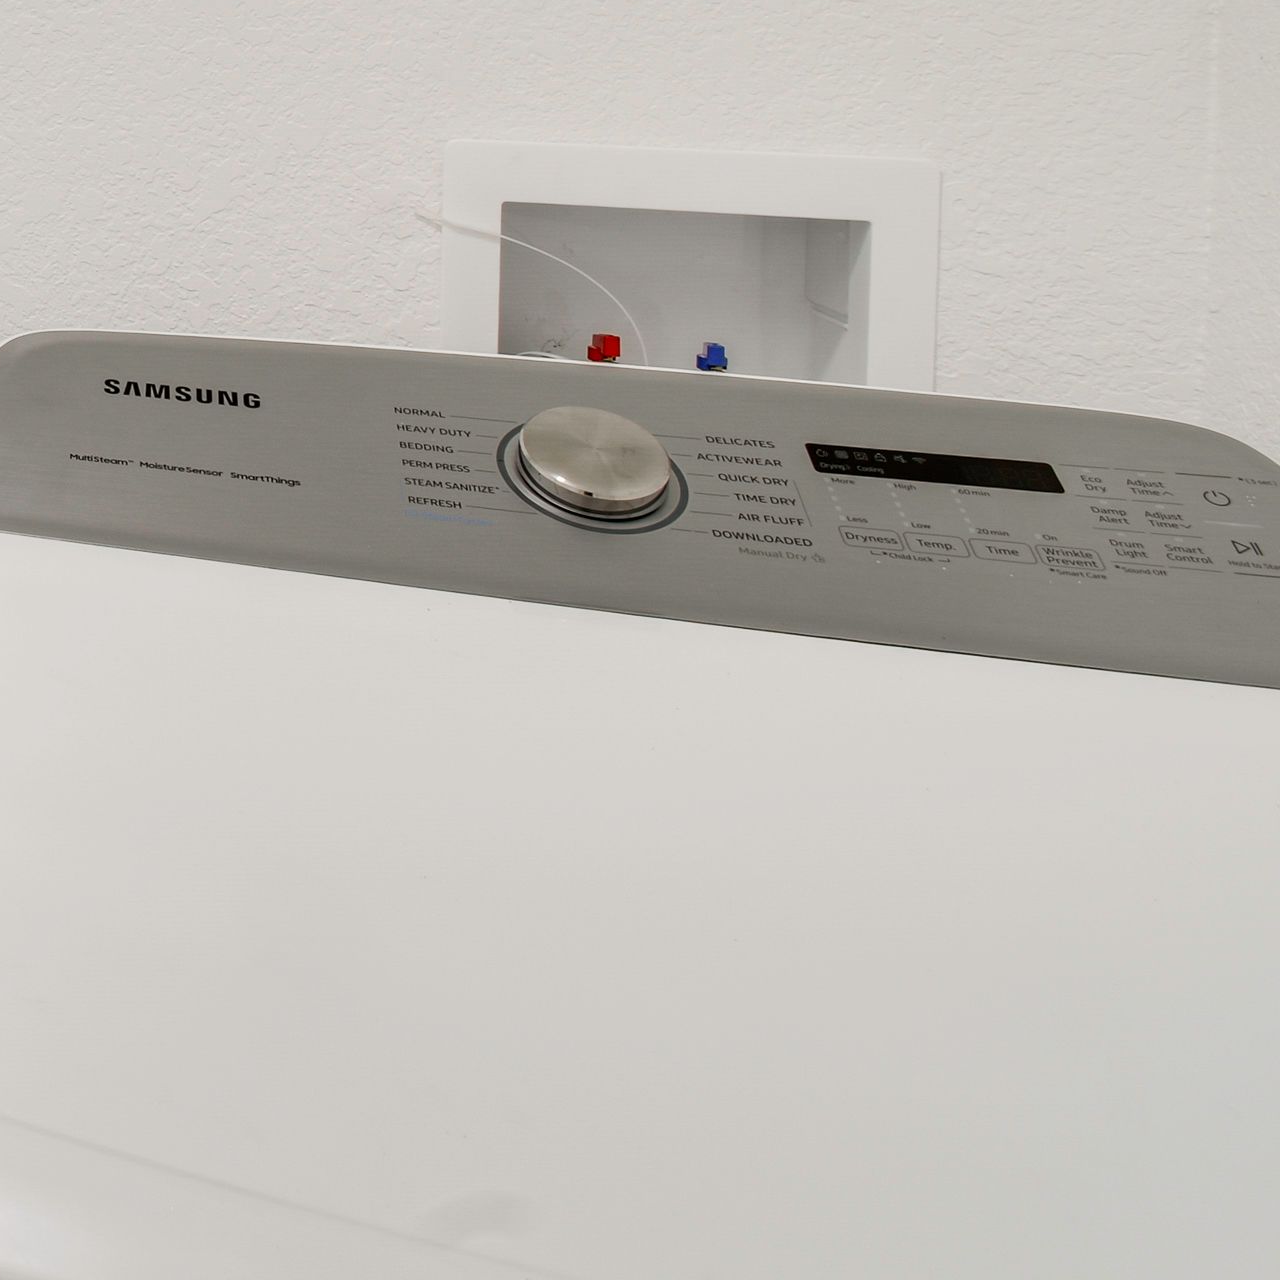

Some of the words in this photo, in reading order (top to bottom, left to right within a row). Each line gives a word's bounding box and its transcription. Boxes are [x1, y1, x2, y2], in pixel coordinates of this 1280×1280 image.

[103, 378, 262, 409] SAMSUNG
[394, 407, 446, 418] NORMAL
[396, 424, 436, 434] HEAVY
[439, 428, 471, 437] DUTY
[399, 441, 454, 453] BEDDING
[705, 435, 775, 448] DELICATES
[697, 453, 783, 467] ACTIVEWEAR
[401, 459, 433, 469] PERM
[435, 463, 471, 473] PRESS
[230, 471, 301, 487] SmartThings
[404, 477, 443, 488] STEAM
[718, 472, 759, 484] QUICK
[762, 477, 788, 486] DRY
[831, 477, 855, 485] More
[1080, 475, 1102, 484] Eco
[1126, 478, 1165, 488] Adjust
[893, 482, 917, 490] High
[1085, 483, 1107, 493] Dry
[1130, 487, 1160, 496] Time
[958, 488, 970, 496] 60
[971, 489, 990, 497] min
[408, 495, 462, 509] REFRESH
[734, 493, 767, 503] TIME
[769, 496, 796, 506] DRY
[1090, 506, 1127, 516] Damp
[1144, 510, 1184, 521] Adjust
[738, 513, 760, 522] AIR
[763, 515, 805, 526] FLUFF
[1098, 515, 1130, 525] Alert
[1148, 519, 1179, 529] Time
[712, 529, 813, 547] DOWNLOADED
[845, 532, 898, 545] Dryness
[990, 529, 1010, 537] min
[1042, 534, 1058, 542] On
[916, 538, 957, 551] Temp.
[1109, 538, 1144, 549] Drum
[1164, 543, 1205, 554] Smart
[738, 547, 782, 558] Manual
[785, 551, 807, 561] Dry
[985, 545, 1019, 557] Time
[1041, 547, 1093, 559] Wrinkle
[1114, 548, 1149, 559] Light
[1046, 555, 1098, 568] Prevent
[1166, 553, 1214, 564] Control
